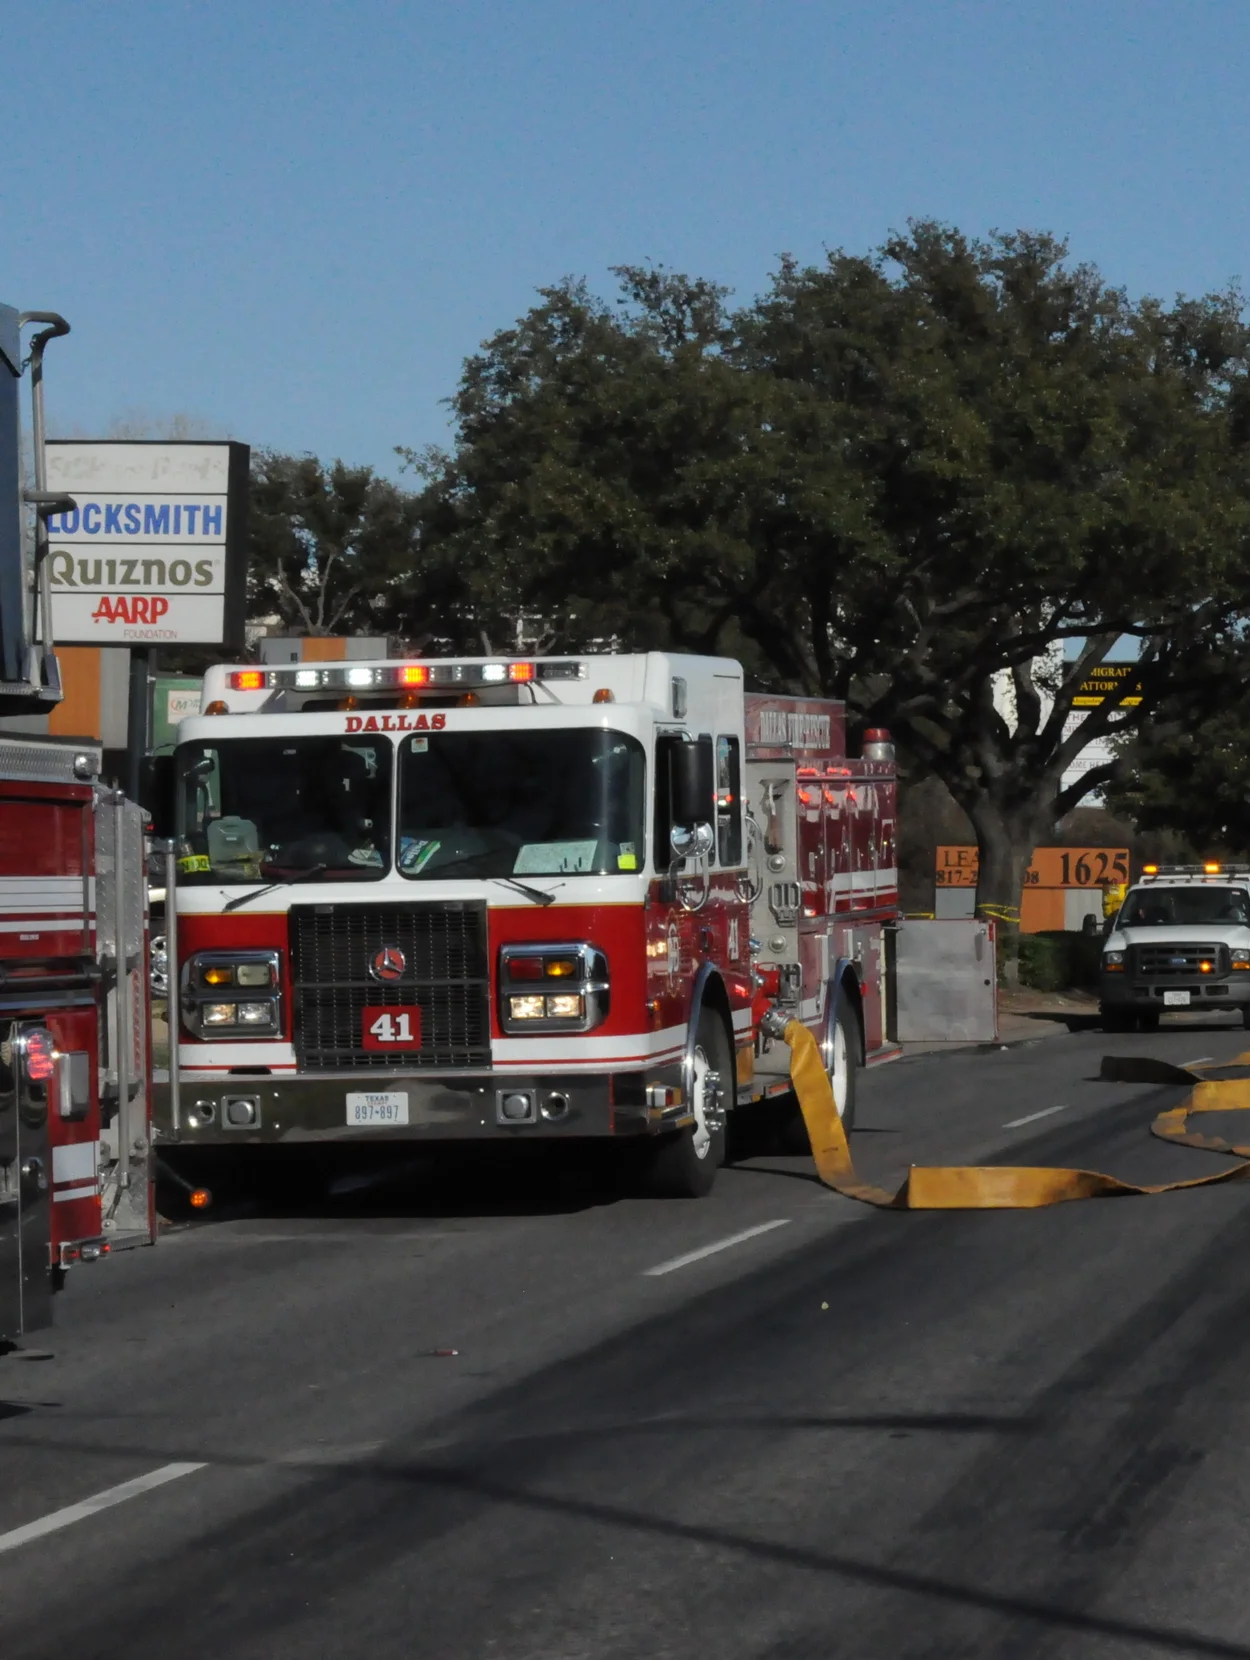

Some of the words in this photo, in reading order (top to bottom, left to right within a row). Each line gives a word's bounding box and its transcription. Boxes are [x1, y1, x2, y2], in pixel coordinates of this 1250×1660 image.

[48, 503, 222, 535] LOCKSMITH
[91, 596, 169, 624] AARP
[123, 629, 178, 639] FOUNDATION
[345, 713, 446, 733] DALLAS
[1060, 852, 1129, 885] 1625
[370, 1013, 414, 1041] 41
